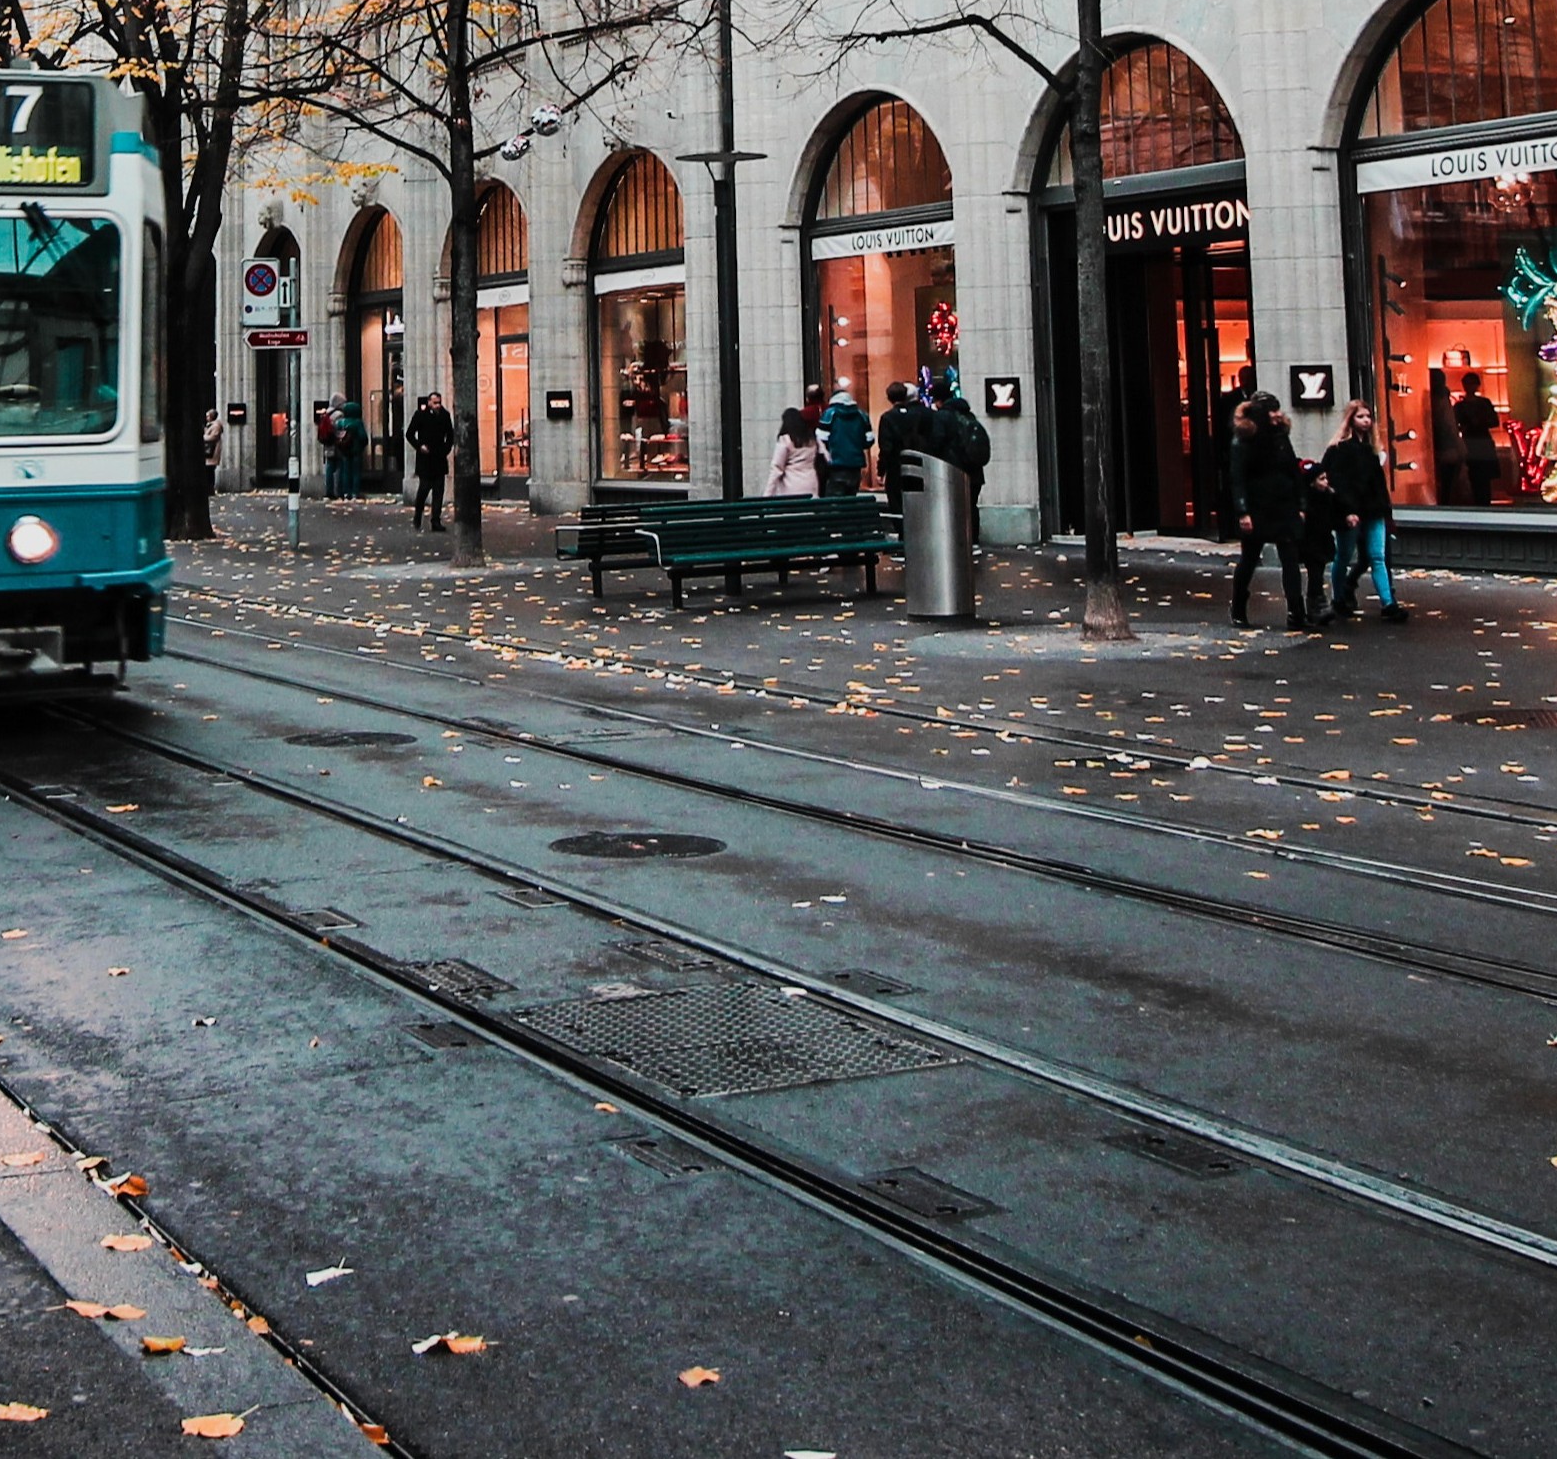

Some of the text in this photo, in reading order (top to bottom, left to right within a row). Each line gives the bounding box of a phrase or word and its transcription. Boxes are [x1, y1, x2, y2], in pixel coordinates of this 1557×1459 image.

[5, 85, 44, 133] 7
[1431, 152, 1487, 177] LOUIS
[1102, 199, 1252, 242] UIS VUITTON
[852, 226, 934, 250] LOUIS VUITTON
